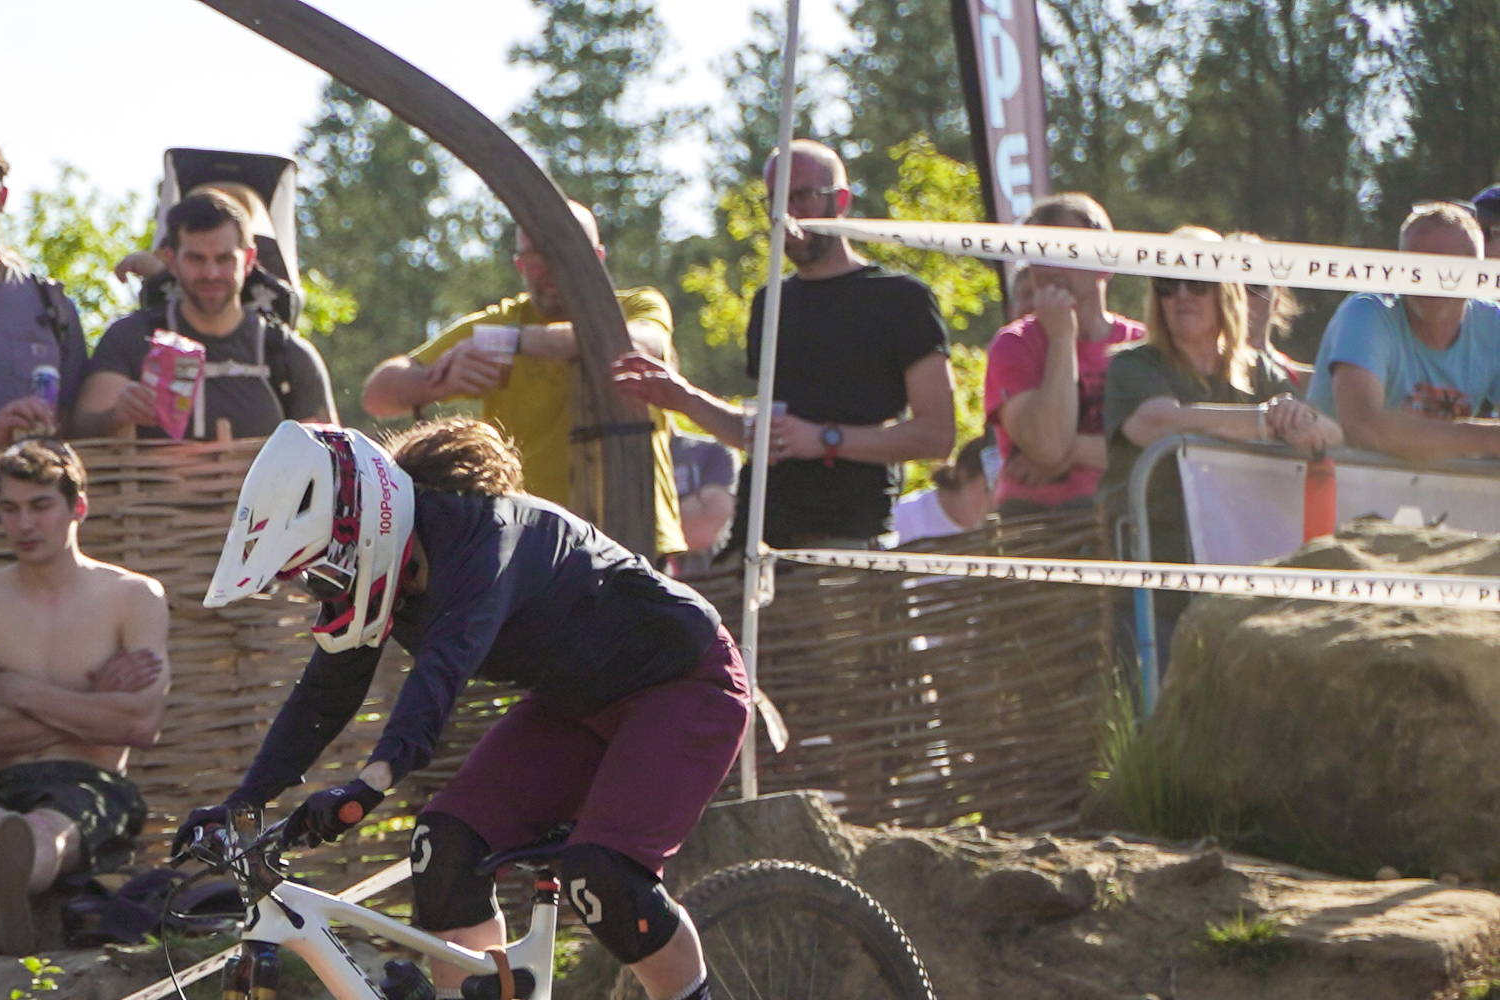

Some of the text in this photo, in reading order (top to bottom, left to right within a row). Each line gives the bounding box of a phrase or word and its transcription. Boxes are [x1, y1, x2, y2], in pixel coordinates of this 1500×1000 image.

[961, 237, 1079, 259] PEATY'S
[1137, 249, 1252, 272] PEATY'S
[1309, 261, 1423, 284] PEATY'S
[372, 457, 392, 536] 100Percent
[966, 562, 1083, 583] PEATY'S
[1141, 571, 1255, 592] PEATY'S
[1312, 579, 1423, 600] PEATY'S
